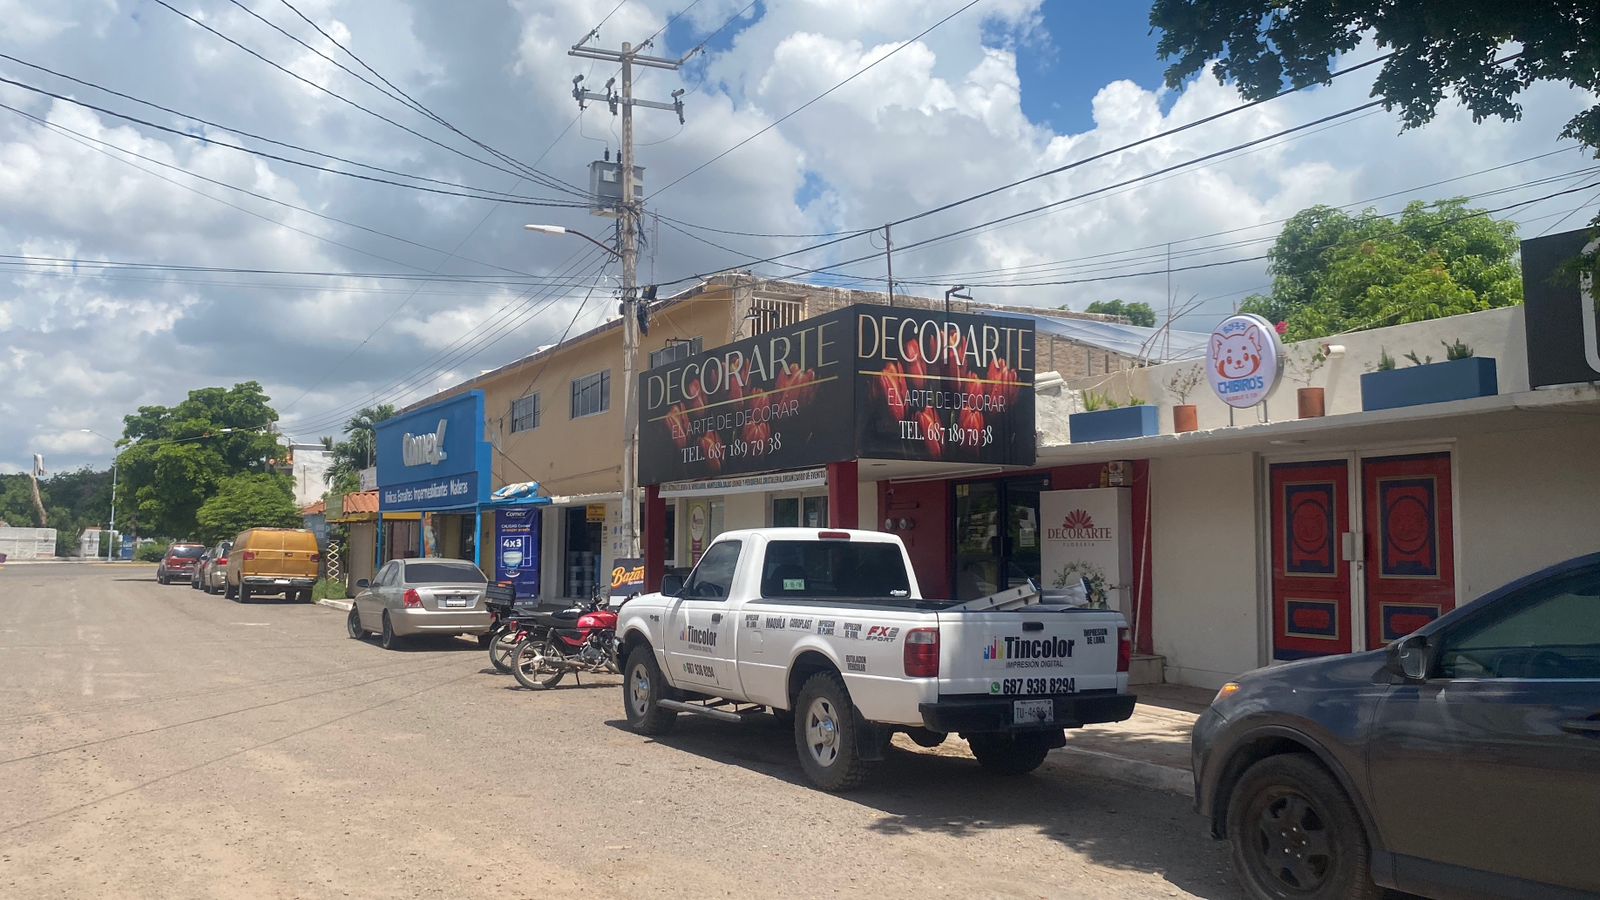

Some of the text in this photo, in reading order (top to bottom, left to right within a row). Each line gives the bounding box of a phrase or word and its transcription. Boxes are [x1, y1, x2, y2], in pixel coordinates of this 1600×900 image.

[857, 314, 1033, 372] DECORARTE
[647, 320, 839, 410] DECORARTE
[1217, 376, 1264, 395] CHIBIRO'S
[888, 388, 1006, 412] EL ARTE DE DECORAR
[671, 399, 800, 440] EL ARTE DE DECORAR
[403, 419, 448, 468] Comex
[899, 420, 994, 447] TEL. 687 189 79 38
[681, 432, 782, 464] TEL. 687 189 79 38
[503, 538, 522, 548] 4x3
[1047, 528, 1113, 539] DECORARTE
[688, 626, 717, 647] Tincolor
[867, 626, 900, 638] FX2
[1084, 628, 1108, 636] IMPRESION
[1004, 636, 1075, 659] Tincolor
[1040, 660, 1063, 669] DIGITAL
[1003, 678, 1075, 694] 687 938 8294
